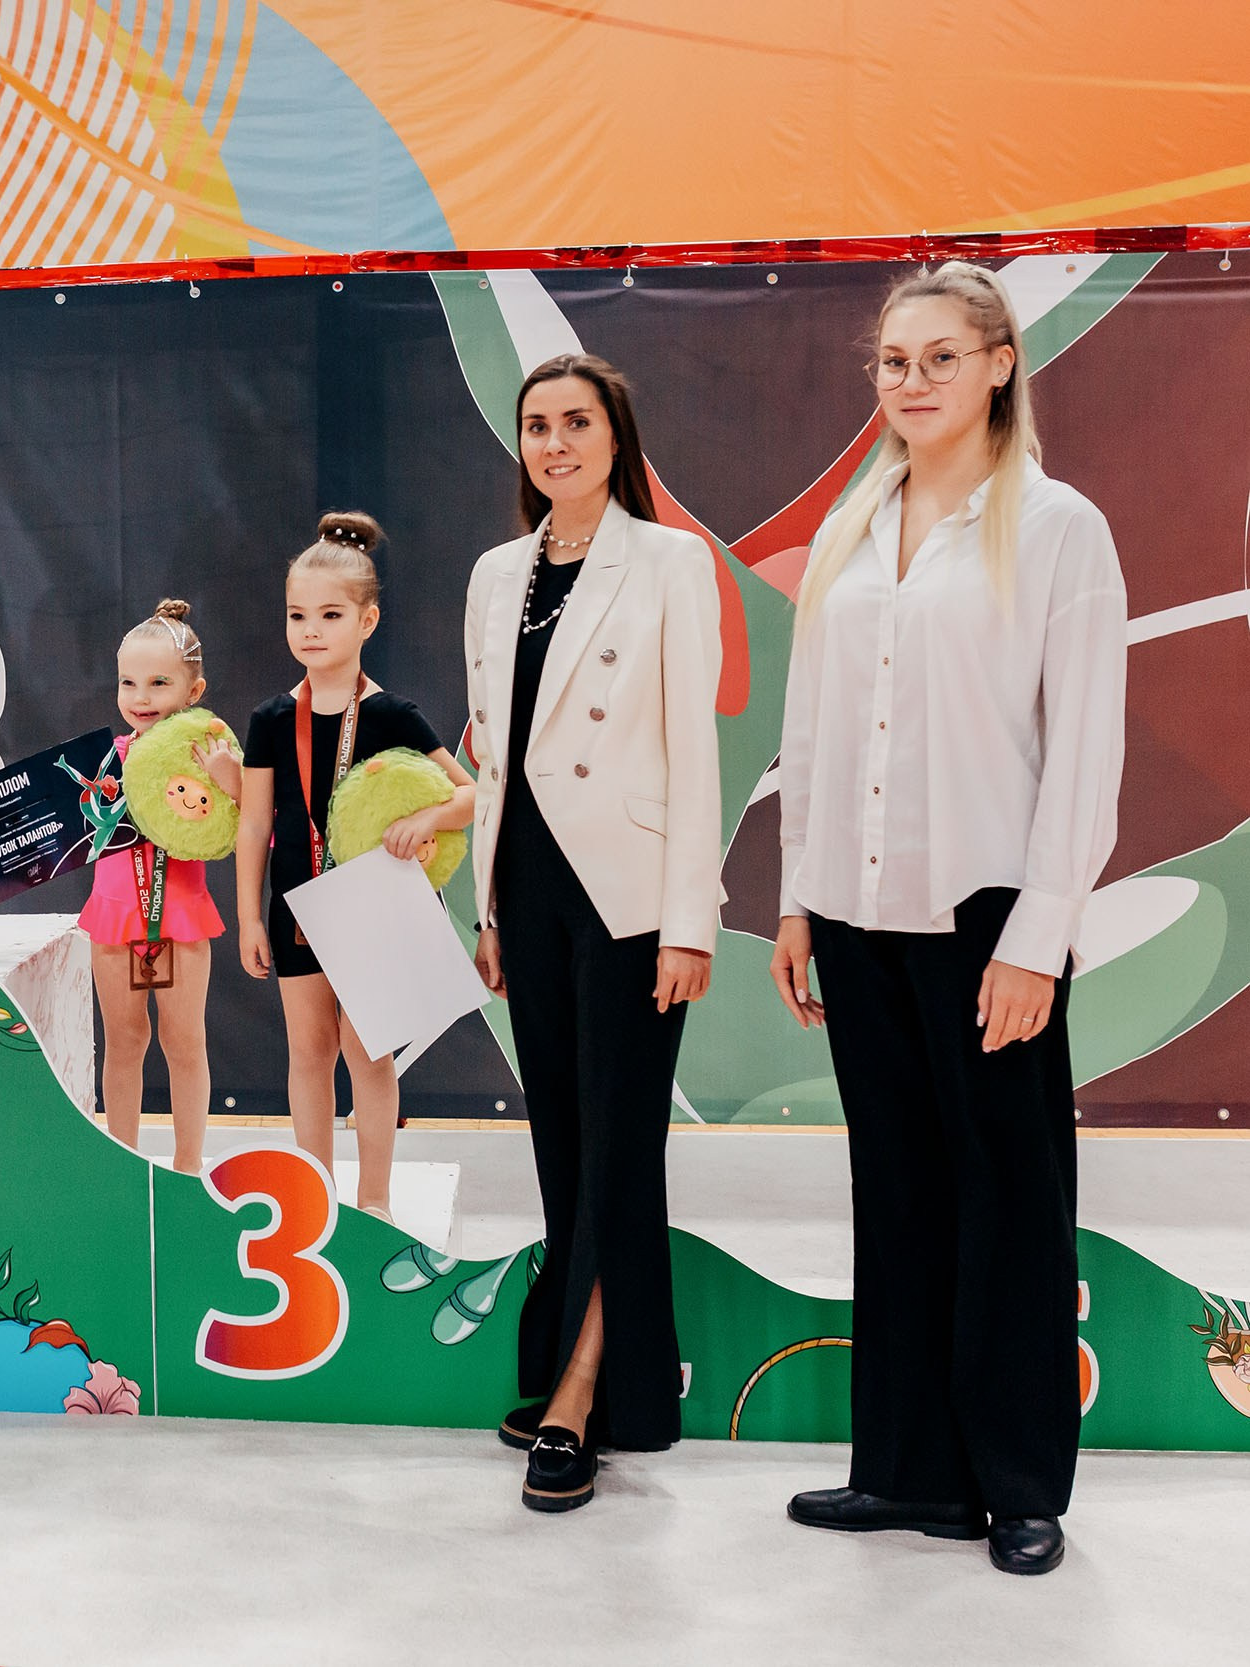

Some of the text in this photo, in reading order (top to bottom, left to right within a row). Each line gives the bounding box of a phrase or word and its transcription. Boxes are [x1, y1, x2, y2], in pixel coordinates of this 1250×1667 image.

[17, 821, 64, 848] ТАЛАНТОВ»
[133, 847, 146, 887] .Казань
[156, 847, 166, 868] тур
[196, 1144, 350, 1381] 3
